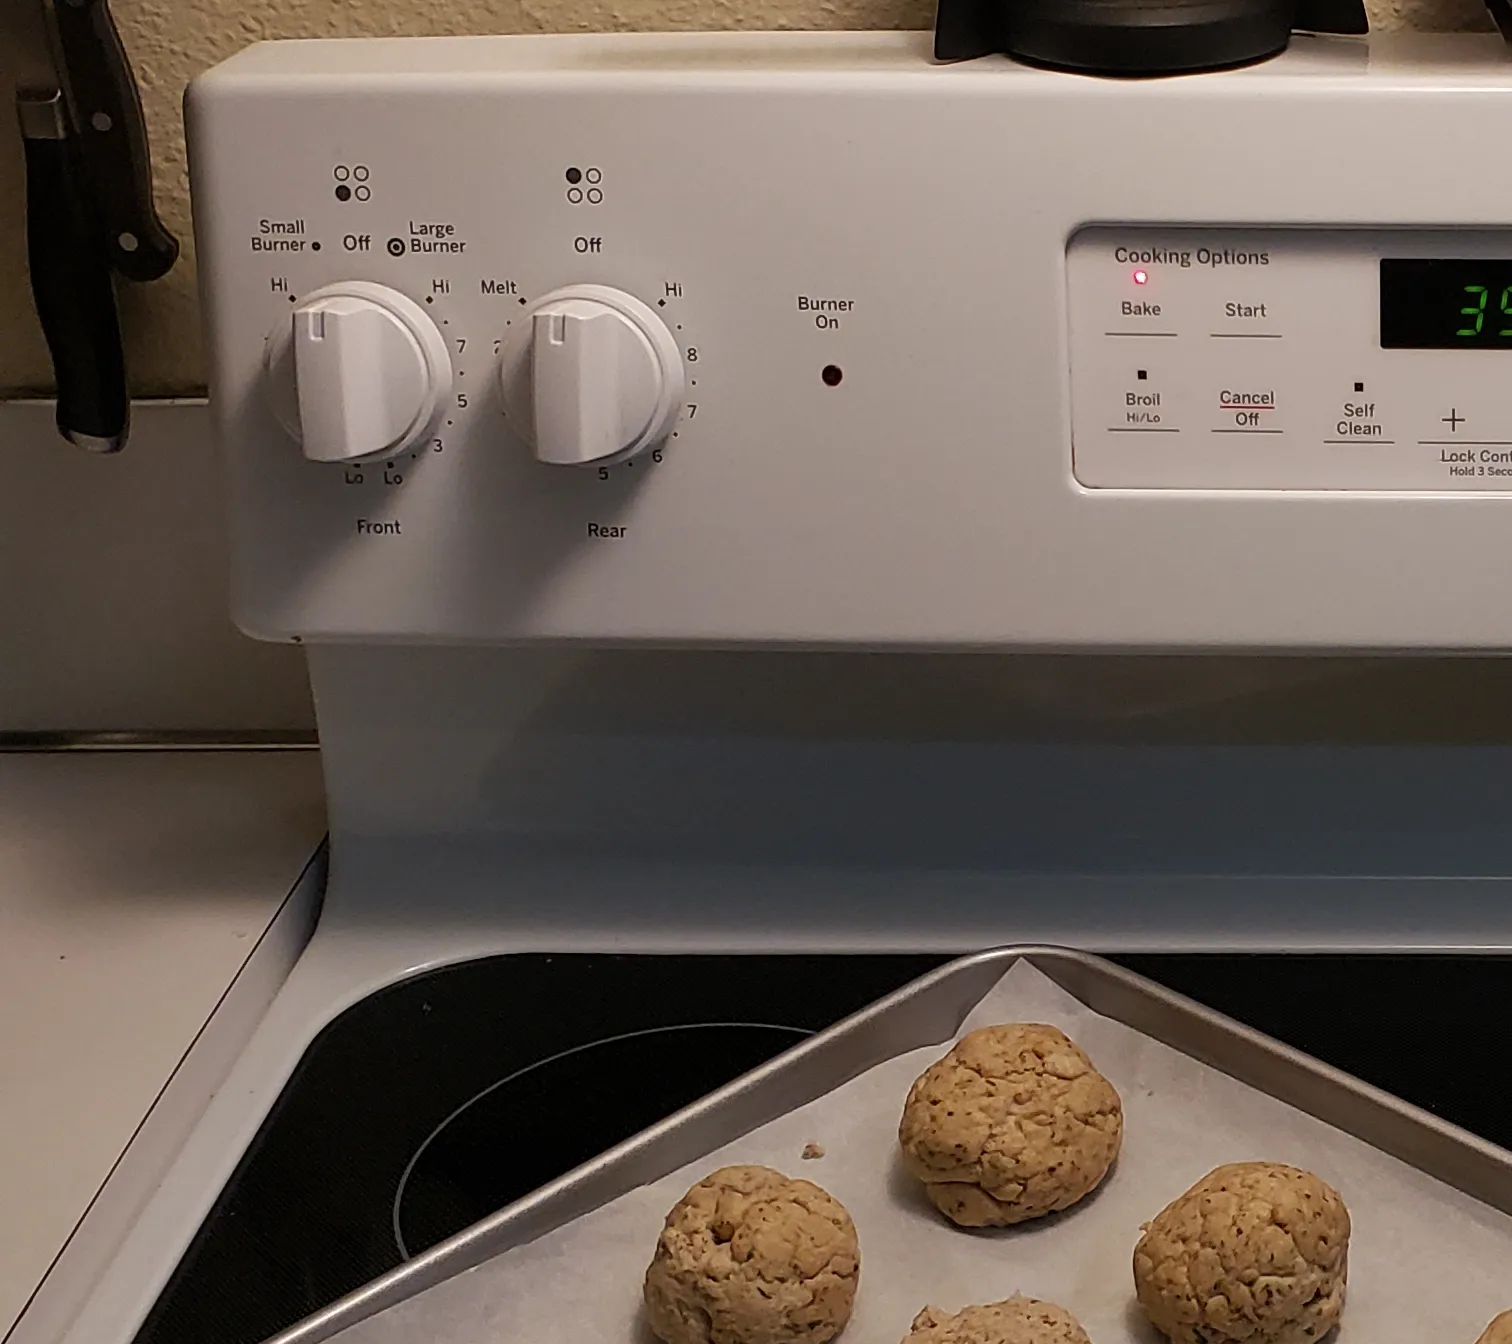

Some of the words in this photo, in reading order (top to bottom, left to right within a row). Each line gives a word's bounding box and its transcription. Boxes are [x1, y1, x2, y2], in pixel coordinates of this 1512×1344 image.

[259, 219, 305, 234] Small
[409, 221, 455, 237] Large
[251, 237, 306, 252] Burner
[343, 235, 371, 251] Off
[411, 239, 466, 253] Burner
[574, 237, 602, 254] Off
[1115, 248, 1191, 267] Cooking
[1196, 249, 1269, 268] Options
[271, 277, 288, 292] Hi
[432, 279, 450, 294] Hi
[481, 280, 517, 294] Melt
[665, 282, 683, 297] Hi
[798, 297, 854, 312] Burner
[1122, 301, 1161, 316] Bake
[1225, 303, 1266, 318] Start
[815, 315, 839, 329] On
[456, 340, 466, 353] 7
[687, 348, 697, 362] 8
[457, 394, 468, 408] 5
[1126, 392, 1160, 406] Broil
[1220, 390, 1274, 405] Cancel
[688, 405, 697, 418] 7
[1126, 412, 1160, 423] Hi/Lo
[1344, 403, 1375, 418] Self
[1235, 412, 1259, 427] Off
[1337, 421, 1382, 435] Clean
[433, 439, 443, 453] 3
[652, 449, 662, 463] 6
[1441, 449, 1476, 463] Lock
[346, 470, 364, 485] Lo
[384, 471, 402, 485] Lo
[598, 467, 609, 480] 5
[1450, 466, 1474, 477] Hold
[1477, 466, 1484, 477] 3
[357, 520, 401, 535] Front
[588, 524, 627, 538] Rear
